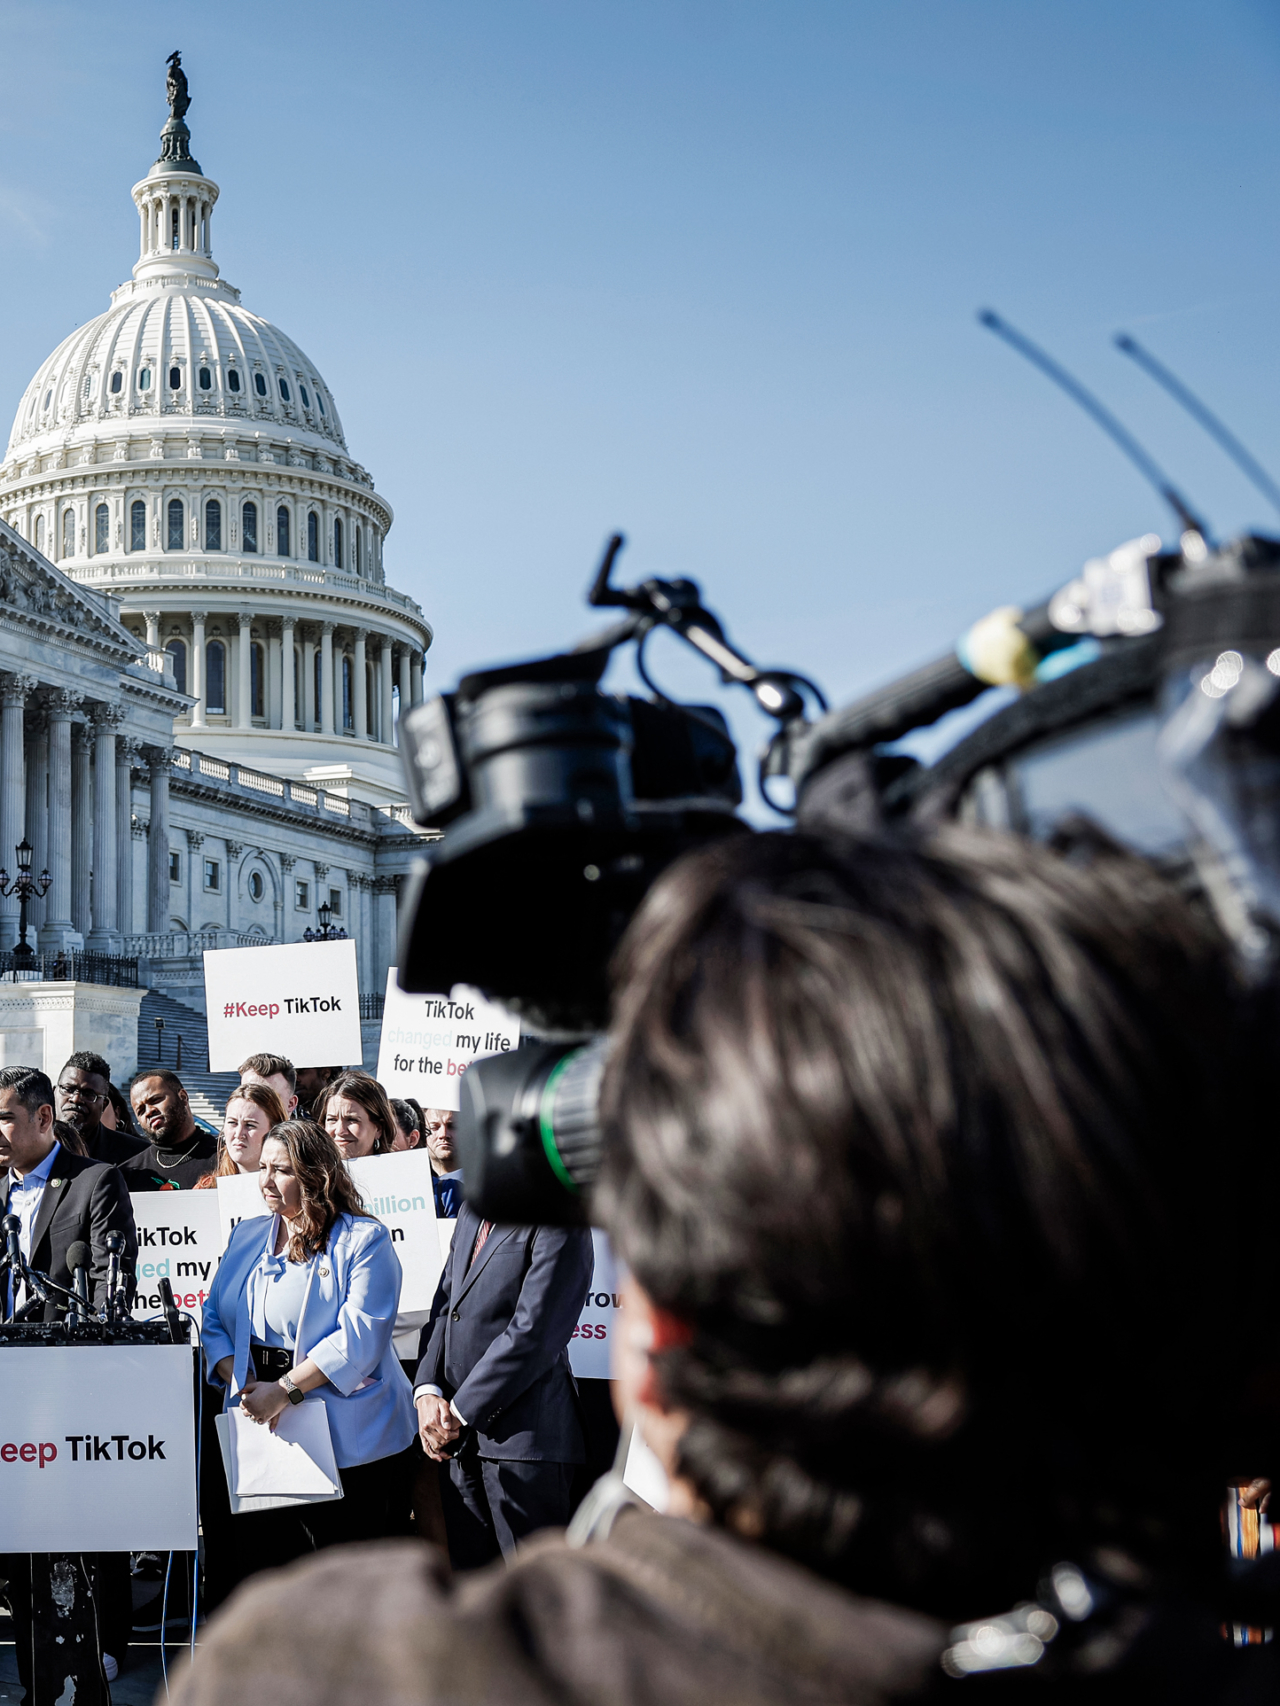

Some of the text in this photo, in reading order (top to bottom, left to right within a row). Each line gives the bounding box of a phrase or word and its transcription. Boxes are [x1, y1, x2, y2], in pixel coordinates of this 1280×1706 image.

[223, 996, 342, 1019] #Keep TikTok
[425, 1000, 475, 1020] TikTok
[387, 1027, 511, 1054] changed my life
[394, 1054, 473, 1077] for the be
[136, 1226, 198, 1247] ikTok
[176, 1261, 212, 1282] my
[134, 1290, 162, 1310] he
[65, 1435, 167, 1461] TikTok
